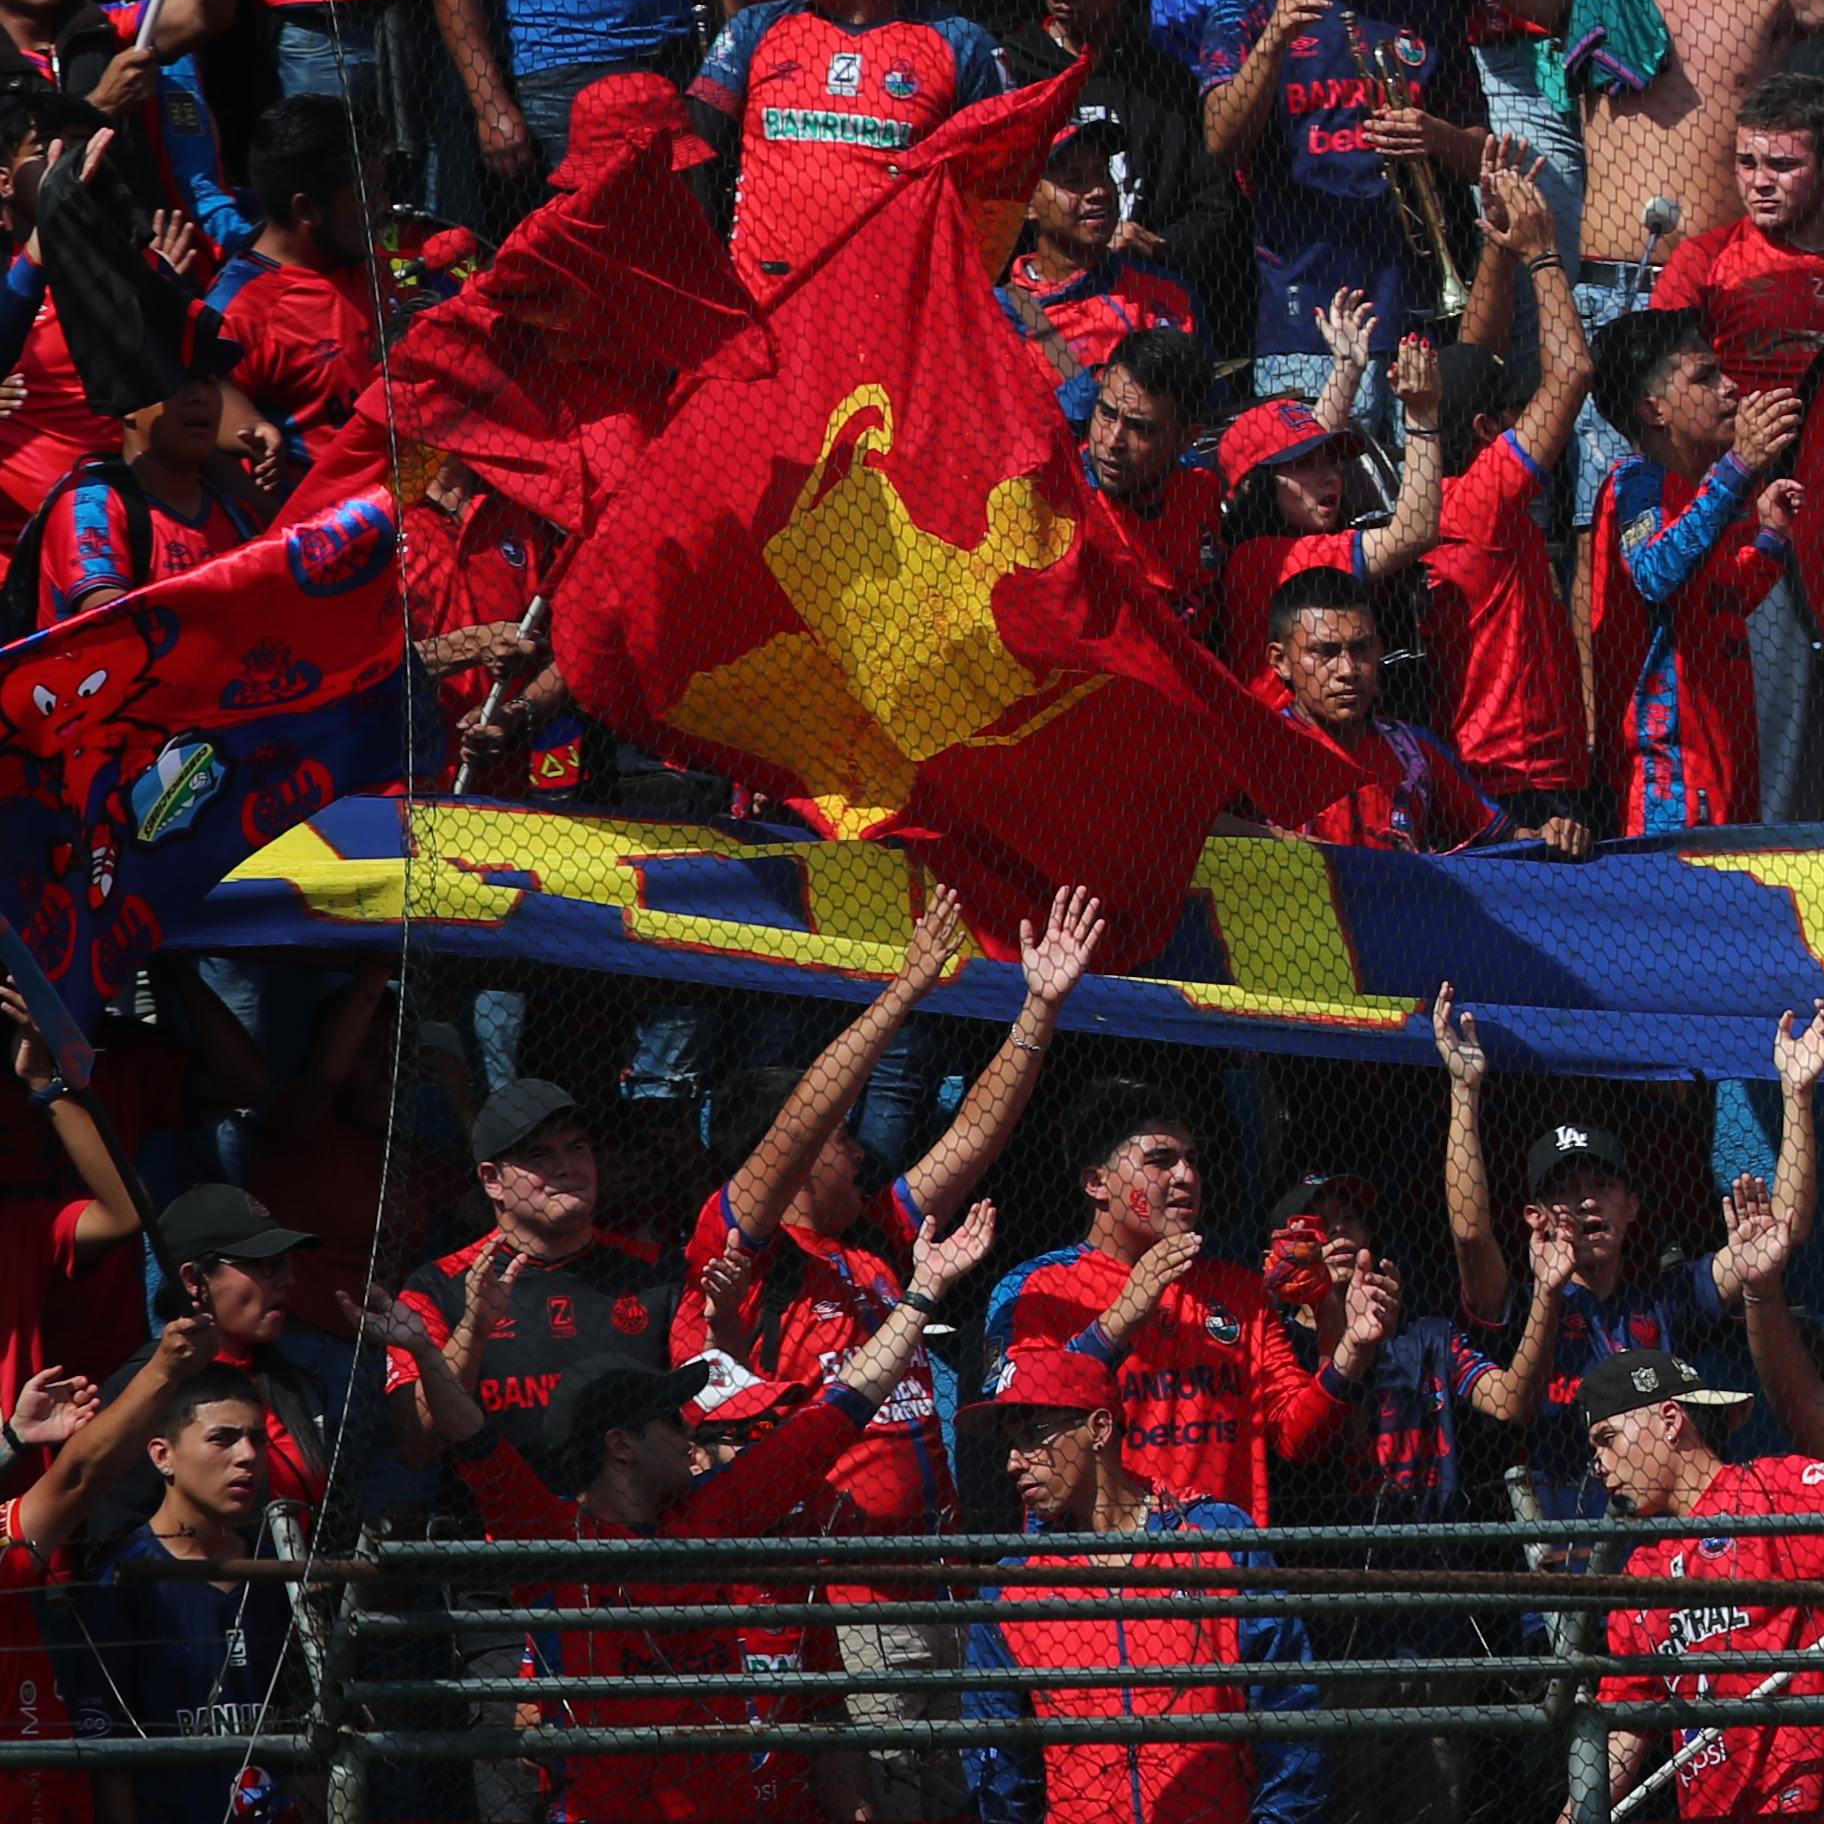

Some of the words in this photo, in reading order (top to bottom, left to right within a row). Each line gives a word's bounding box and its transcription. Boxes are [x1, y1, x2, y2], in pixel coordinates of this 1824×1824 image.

[767, 109, 913, 151] BANRURAL
[1555, 1125, 1589, 1152] LA
[1121, 1365, 1243, 1403] ANRURAL
[1126, 1414, 1239, 1451] betcris
